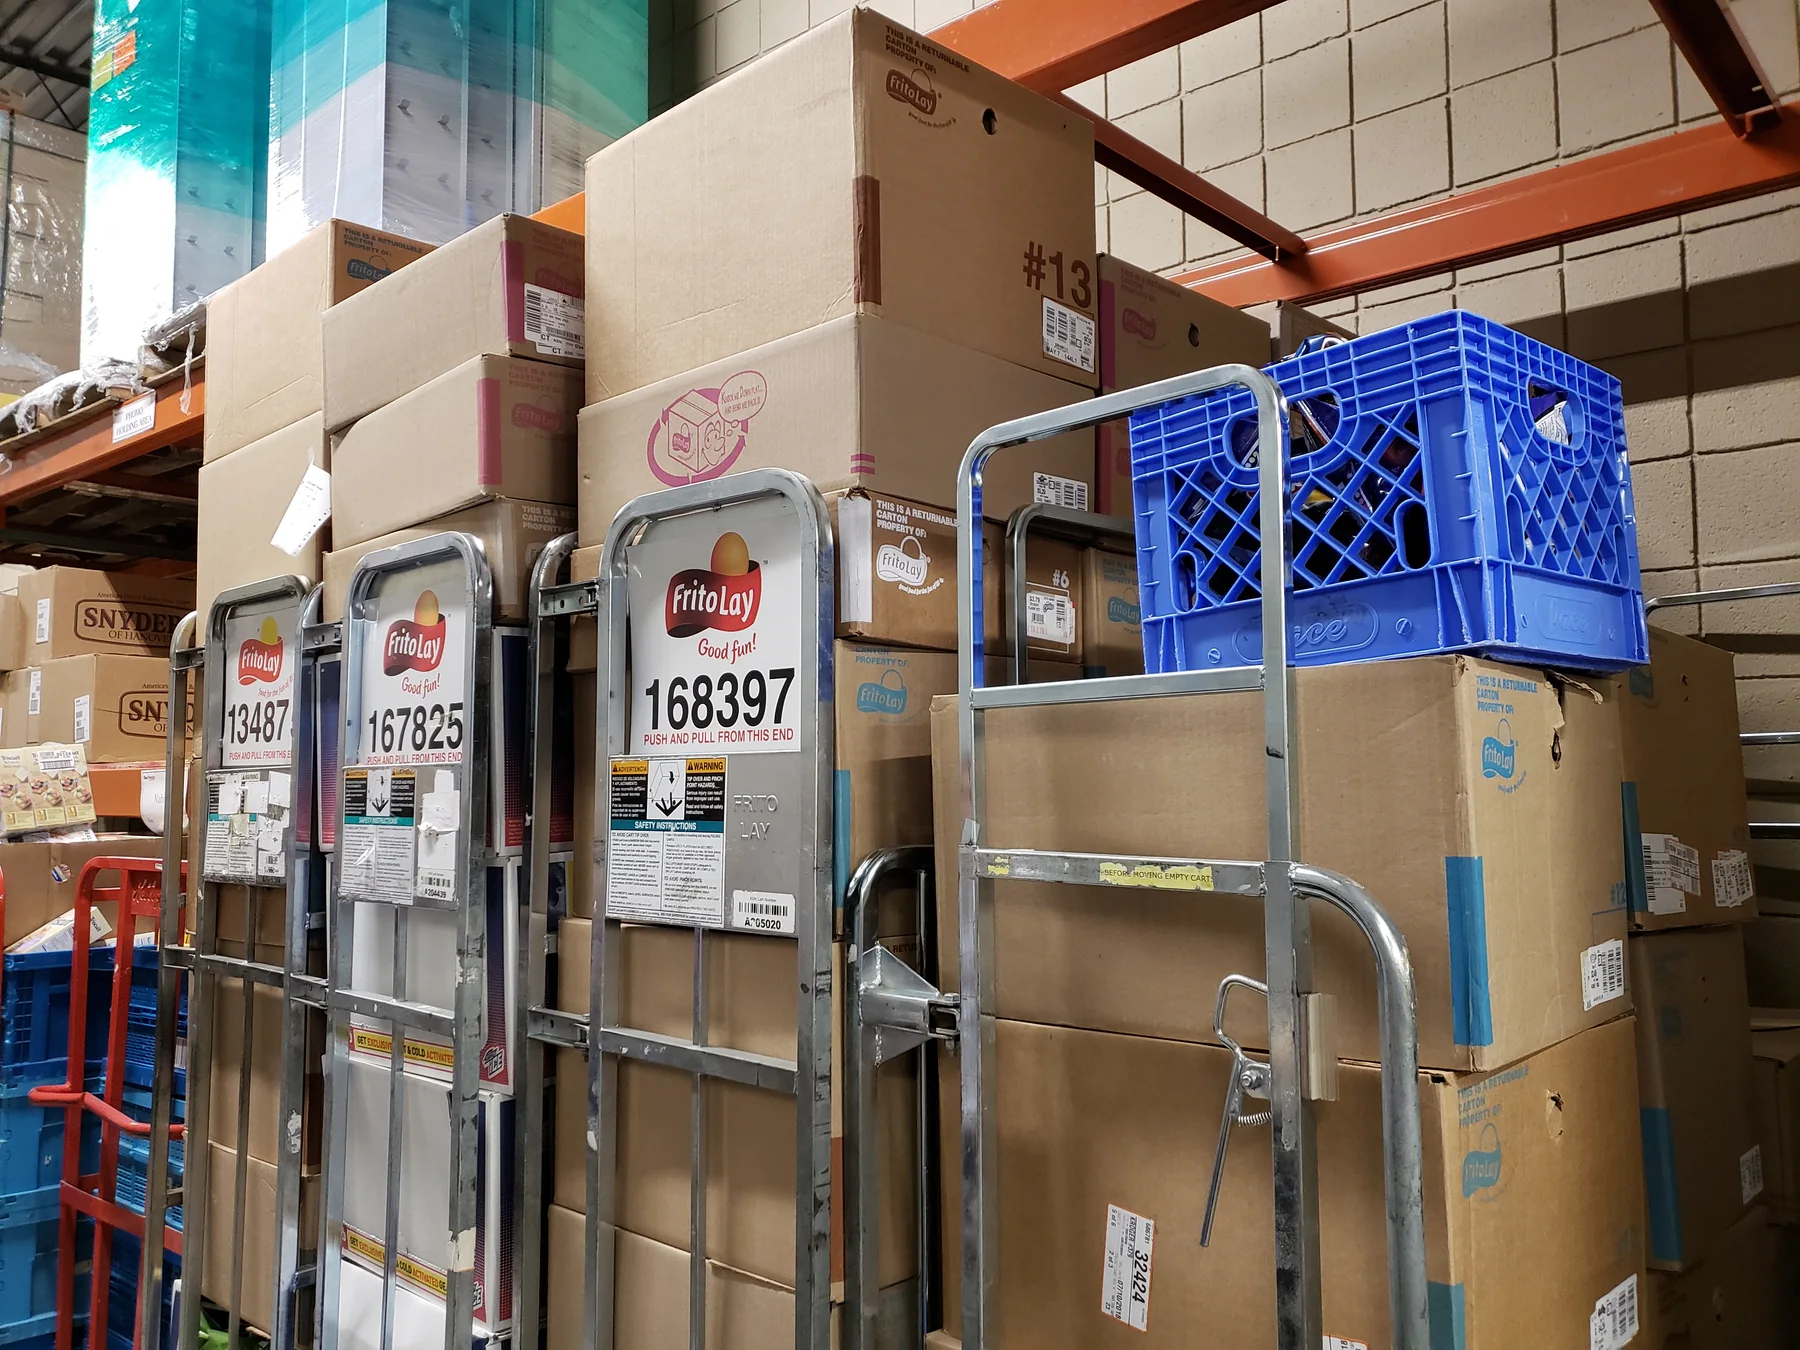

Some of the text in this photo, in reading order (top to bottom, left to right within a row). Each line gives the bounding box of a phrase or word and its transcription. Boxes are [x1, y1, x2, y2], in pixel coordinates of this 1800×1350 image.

[886, 35, 917, 56] CARTON
[886, 25, 969, 72] THIS IS A RETURNABLE
[886, 44, 924, 68] PROPERTY
[344, 234, 374, 246] CARTON
[344, 228, 423, 254] THIS IS A RETURNABLE
[344, 240, 379, 253] PROPERTY
[1023, 240, 1092, 308] #13
[540, 334, 550, 342] CT
[126, 406, 144, 420] PROMO
[116, 416, 152, 436] HOLDING AREA
[522, 505, 541, 514] THIS
[543, 508, 551, 516] IS
[522, 514, 556, 524] CARTON
[876, 500, 958, 528] THIS IS A RETURNABLE
[876, 510, 908, 524] CARTON
[522, 522, 560, 532] PROPERTY
[876, 518, 914, 534] PROPERTY
[1052, 569, 1070, 588] #6
[108, 630, 172, 643] OF HANOVE
[698, 632, 757, 664] Good fun!
[856, 656, 896, 666] PROPERTY
[402, 672, 440, 699] Good fun!
[1477, 676, 1537, 693] THIS IS A RETURNABLE
[646, 667, 795, 730] 168397
[1477, 688, 1499, 700] CARTON
[1478, 701, 1504, 713] PROPERTY
[228, 698, 293, 744] 13487
[368, 702, 464, 753] 167825
[644, 728, 794, 746] PUSH AND PULL FROM THIS END
[229, 750, 287, 760] PUSH AND PULL FROM THIS
[368, 751, 463, 765] PUSH AND PULL FROM THIS END
[618, 764, 647, 772] ADVERTENCIA
[694, 762, 723, 771] WARNING
[733, 794, 778, 812] FRITO
[635, 821, 696, 830] SAFETY INSTRUCTIONS
[740, 822, 770, 840] LAY
[1133, 871, 1162, 879] MOVING
[1164, 873, 1188, 881] EMPTY
[357, 1036, 367, 1045] GET
[367, 1038, 392, 1051] EXCLUSIVE
[408, 1046, 412, 1054] &
[412, 1047, 426, 1057] COLD
[1458, 1066, 1529, 1098] THIS IS A RETURNABLE
[1458, 1096, 1486, 1115] CARTON
[1459, 1108, 1492, 1128] PROPERTY
[1111, 1214, 1116, 1222] of
[1128, 1216, 1137, 1241] KROGER
[350, 1236, 358, 1246] GET
[359, 1241, 383, 1259] EXCLUSIVE
[400, 1261, 412, 1274] COLD
[412, 1266, 438, 1288] ACTIVATED
[1132, 1249, 1149, 1304] 32424
[1105, 1301, 1110, 1310] 23
